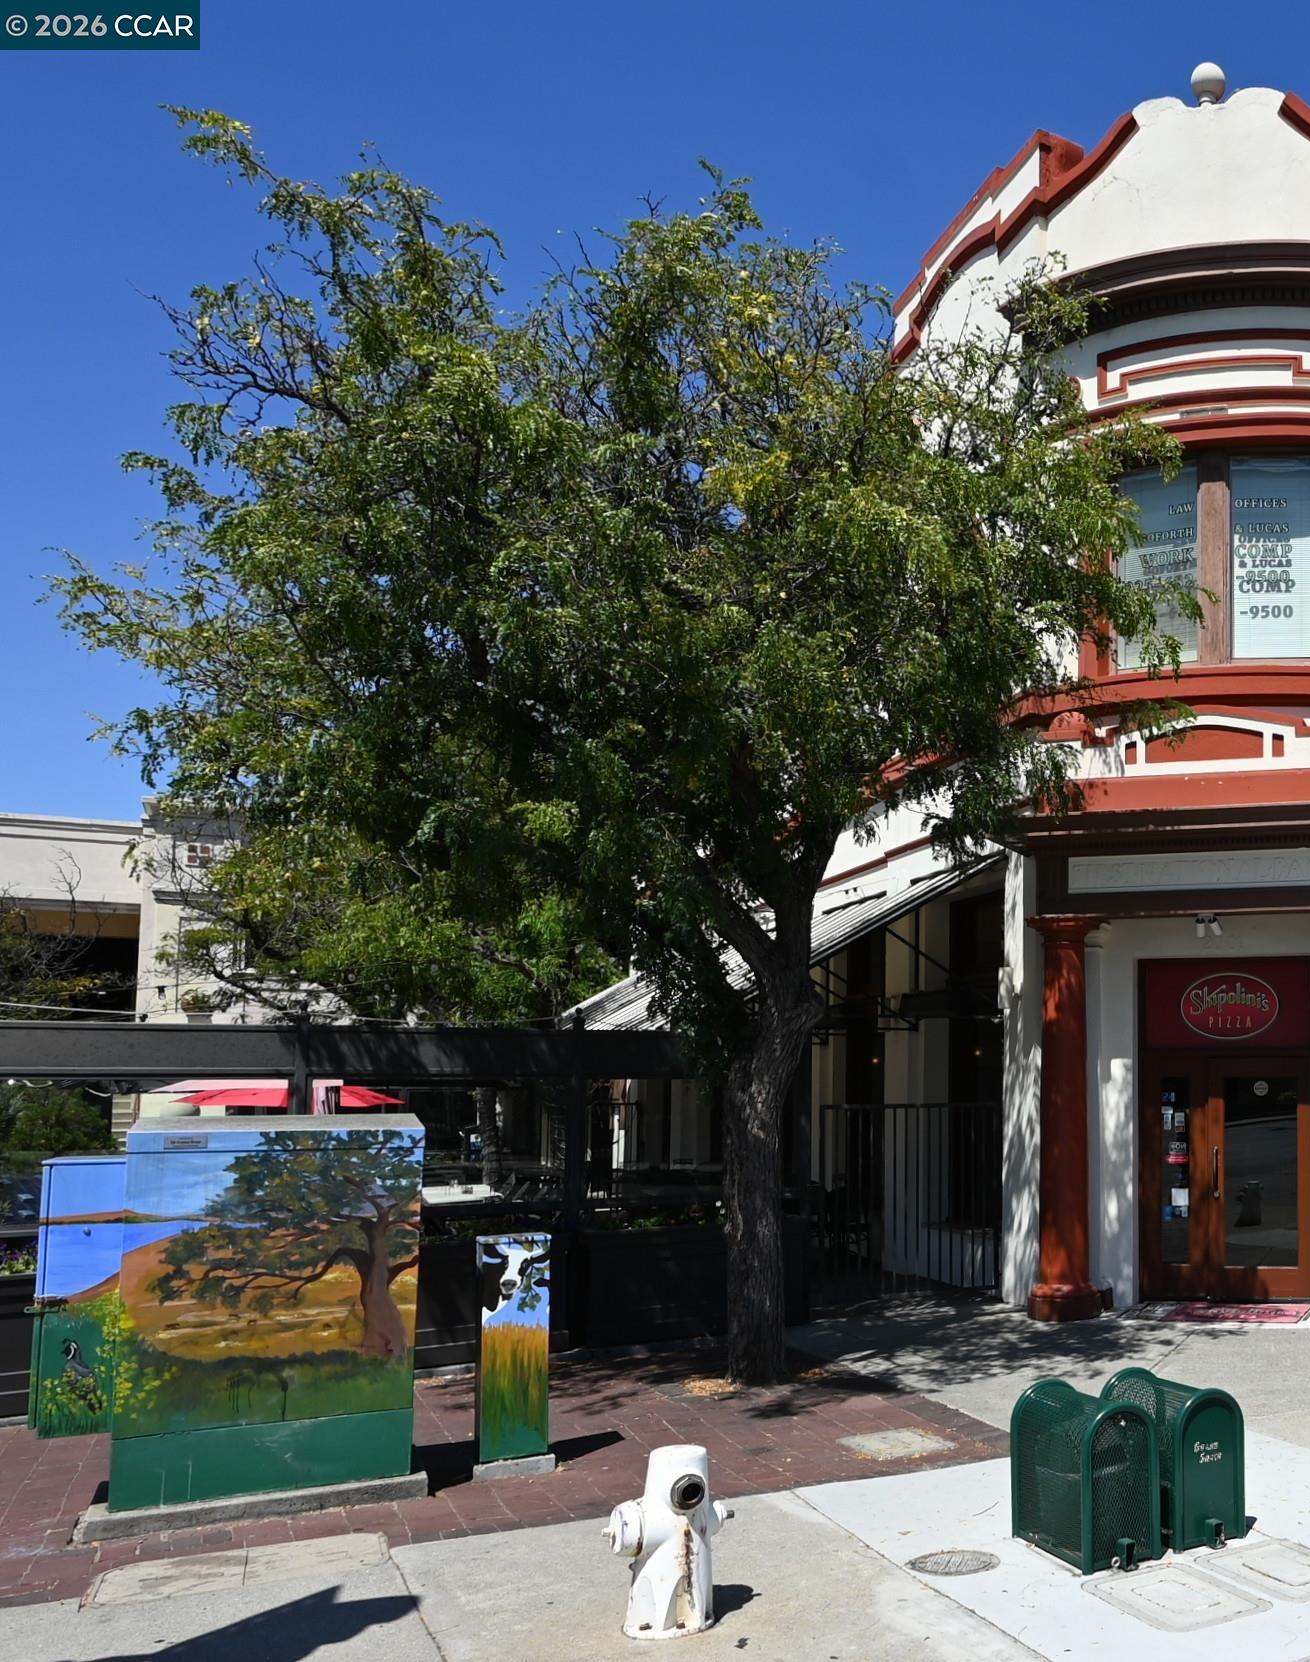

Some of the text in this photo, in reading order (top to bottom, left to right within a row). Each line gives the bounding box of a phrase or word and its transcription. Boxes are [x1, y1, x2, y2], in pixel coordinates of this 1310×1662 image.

[1168, 498, 1288, 516] LAW OFFICES
[1142, 523, 1290, 542] OFORTH & LUCAS
[1139, 543, 1293, 568] WORK COMP
[1236, 570, 1291, 583] -9500
[1189, 982, 1270, 1015] Skipolini's
[1209, 1016, 1252, 1028] PIZZA
